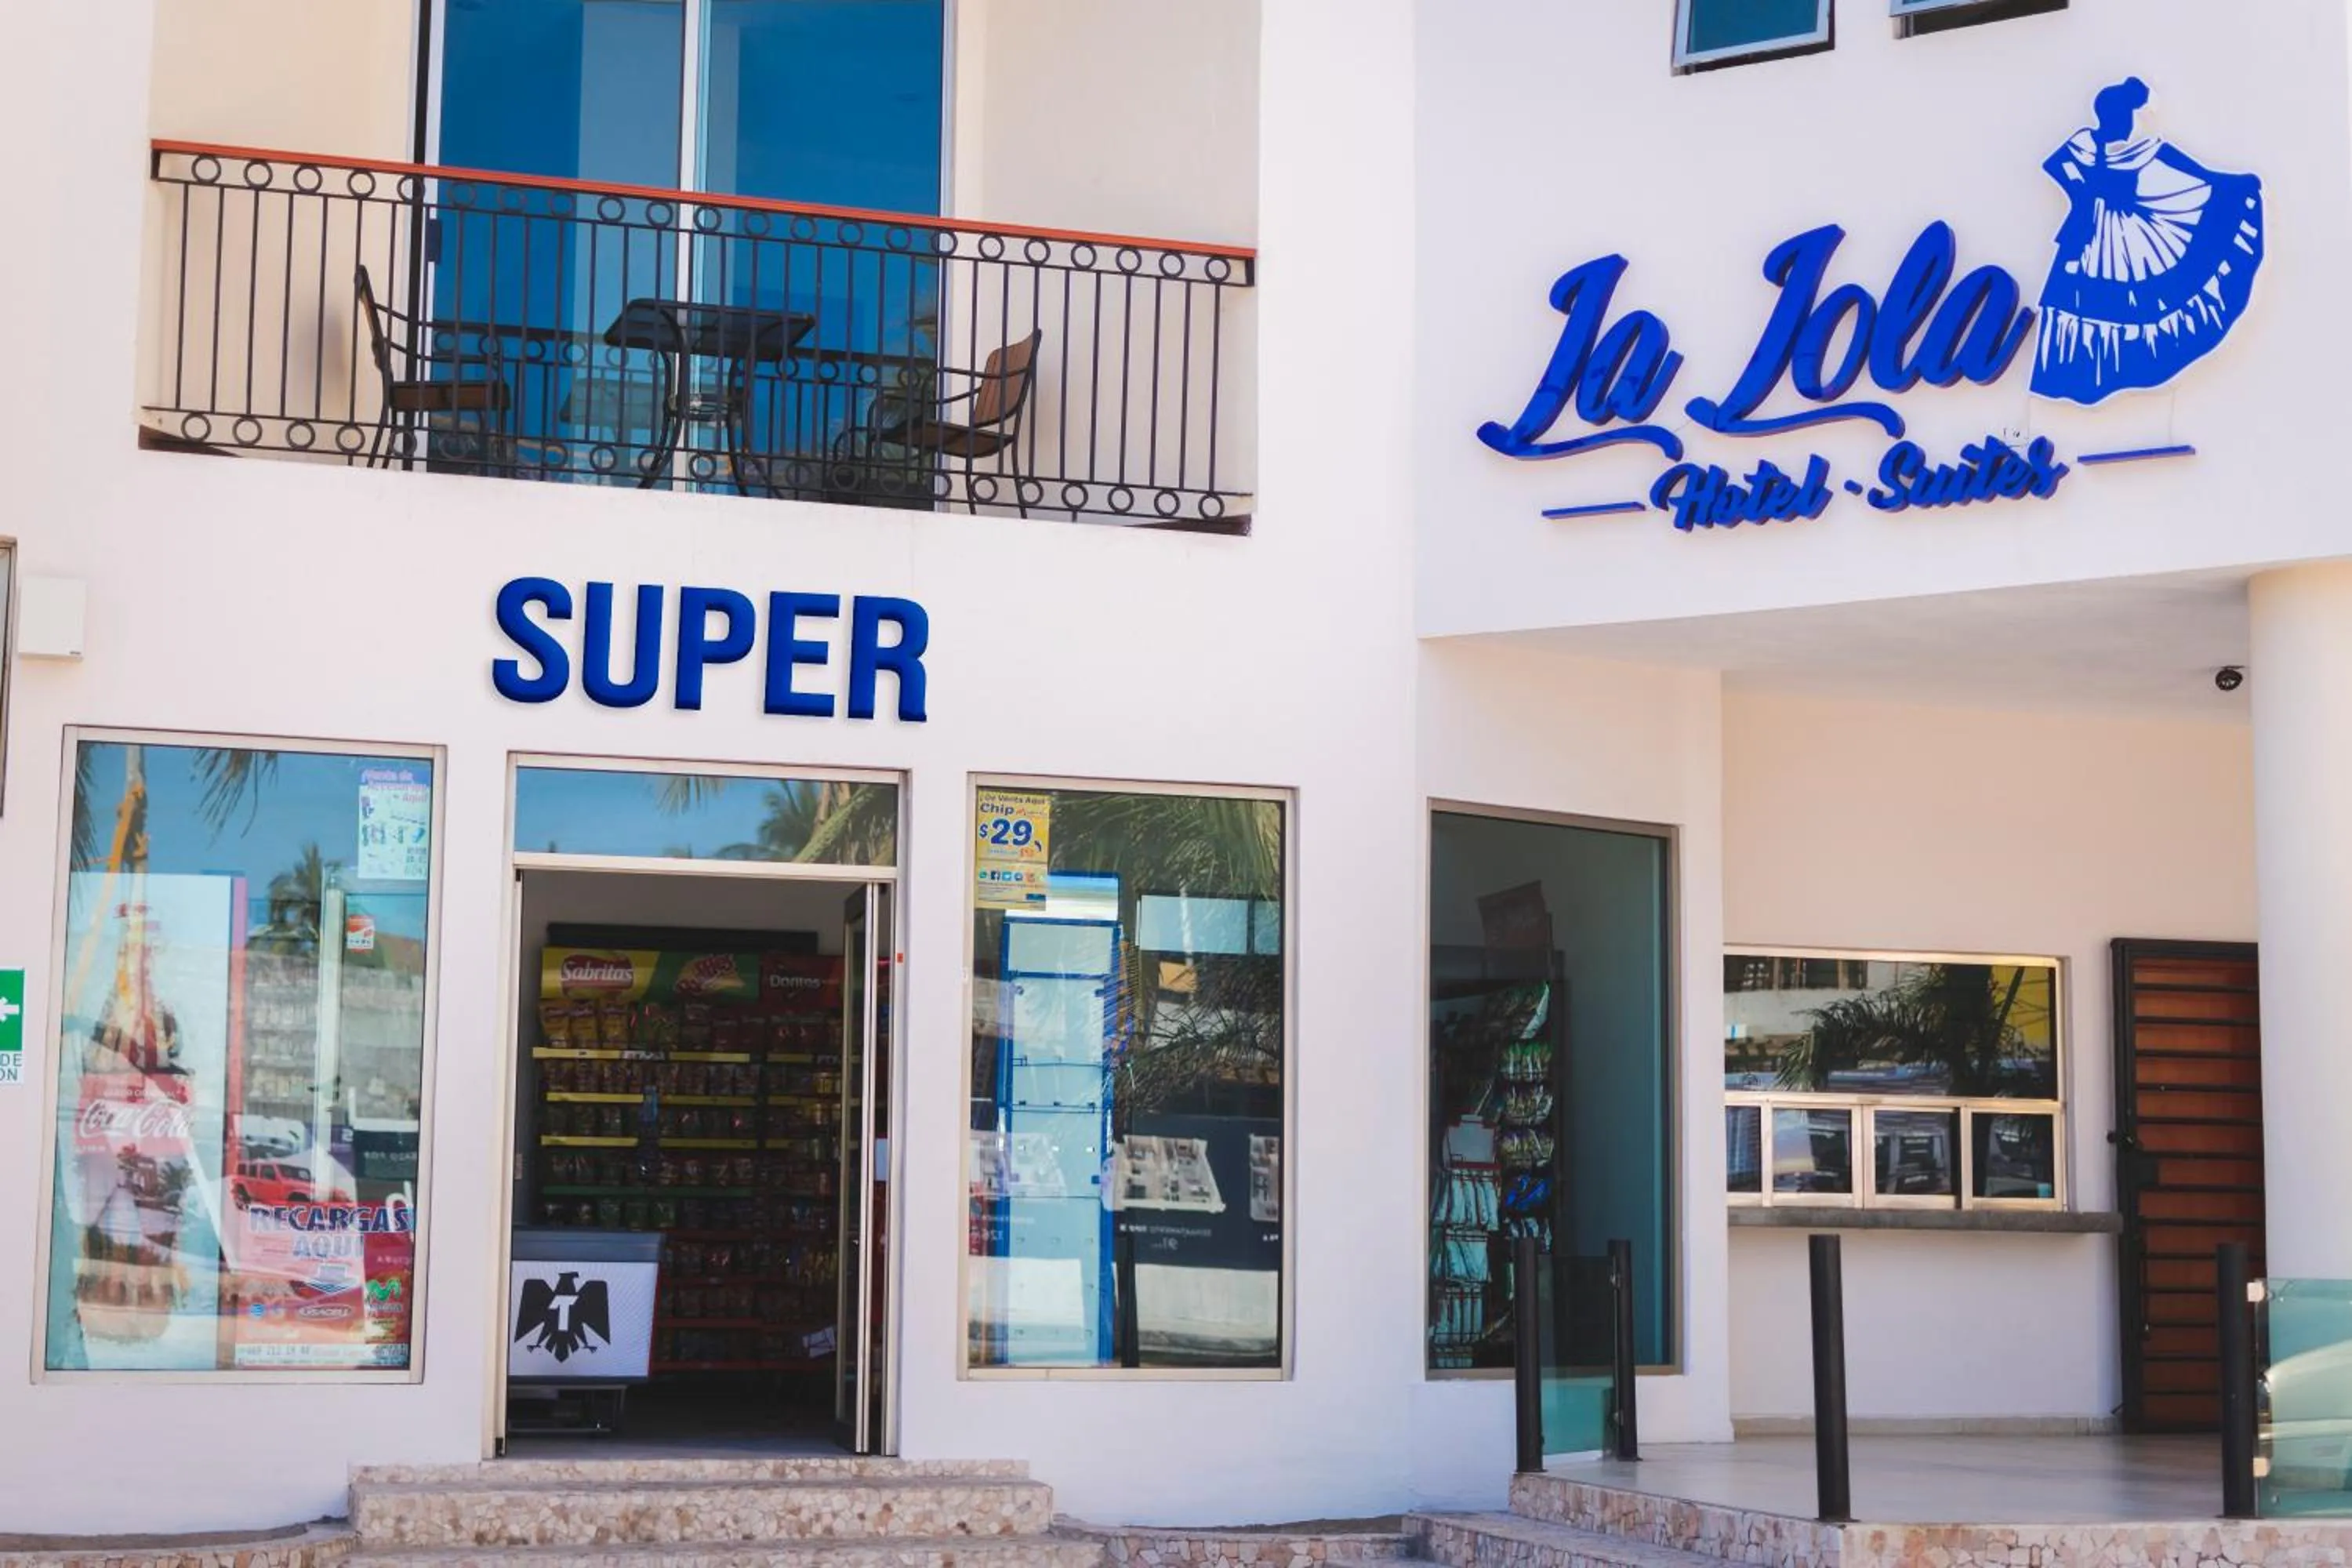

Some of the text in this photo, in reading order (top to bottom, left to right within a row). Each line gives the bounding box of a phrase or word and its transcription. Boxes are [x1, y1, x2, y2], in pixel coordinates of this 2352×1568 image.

[1477, 220, 2035, 461] La Lola
[1650, 436, 2070, 533] Hotel Suites
[492, 576, 929, 723] SUPER
[980, 802, 1014, 816] Chip
[561, 961, 633, 982] Sabritas
[769, 974, 821, 989] Doritos
[249, 1205, 415, 1233] RECARGAS
